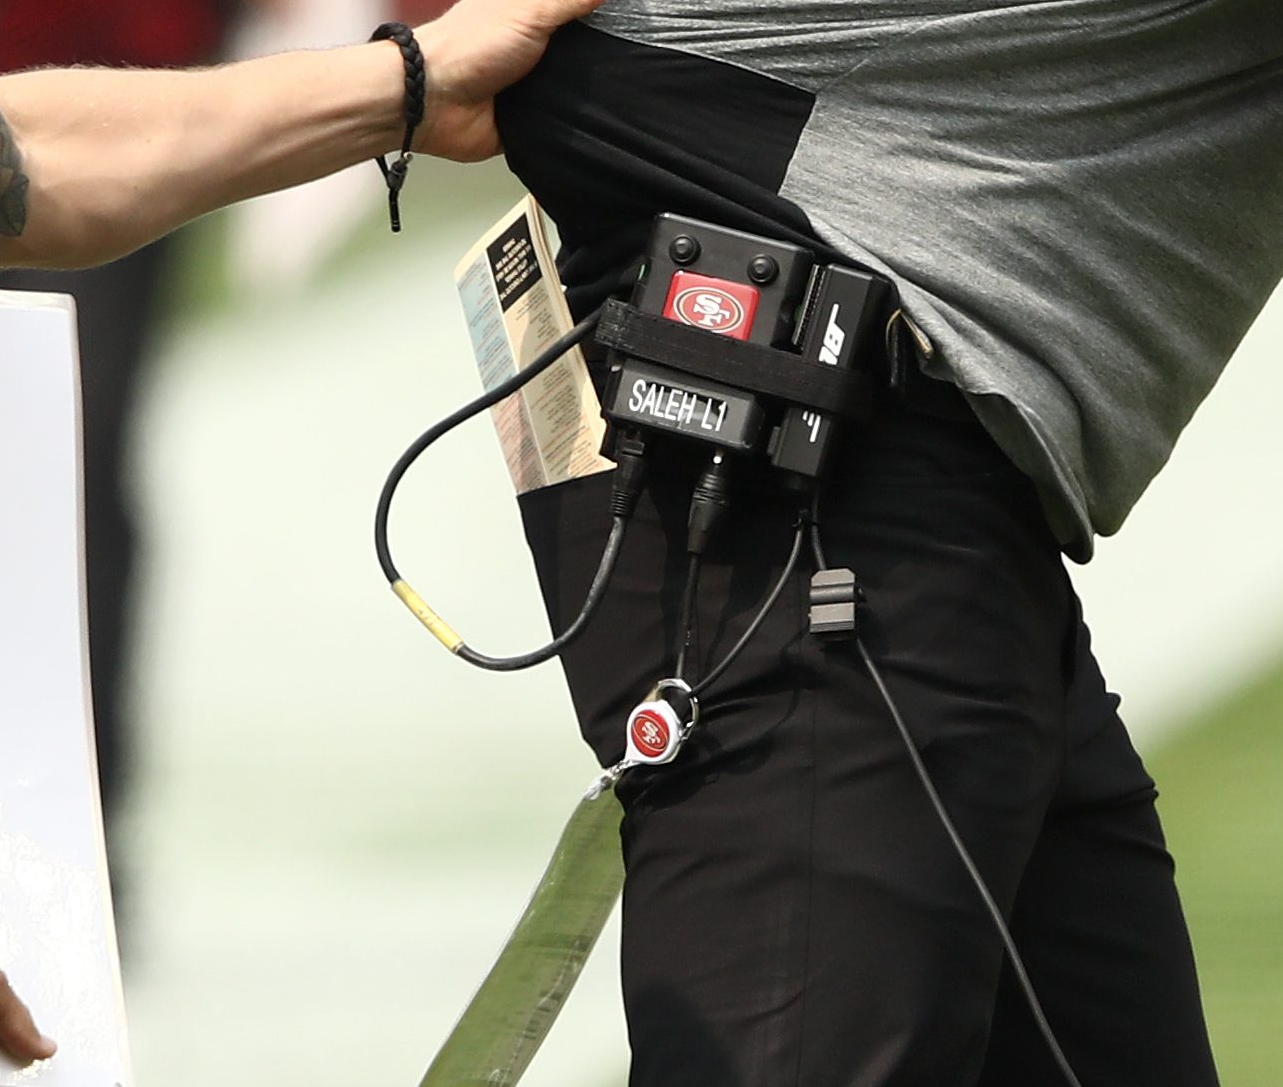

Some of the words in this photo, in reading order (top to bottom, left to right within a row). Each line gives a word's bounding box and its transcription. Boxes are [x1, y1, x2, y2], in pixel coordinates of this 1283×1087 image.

[692, 293, 731, 327] SF
[628, 379, 697, 424] SALEH
[700, 398, 727, 432] L1
